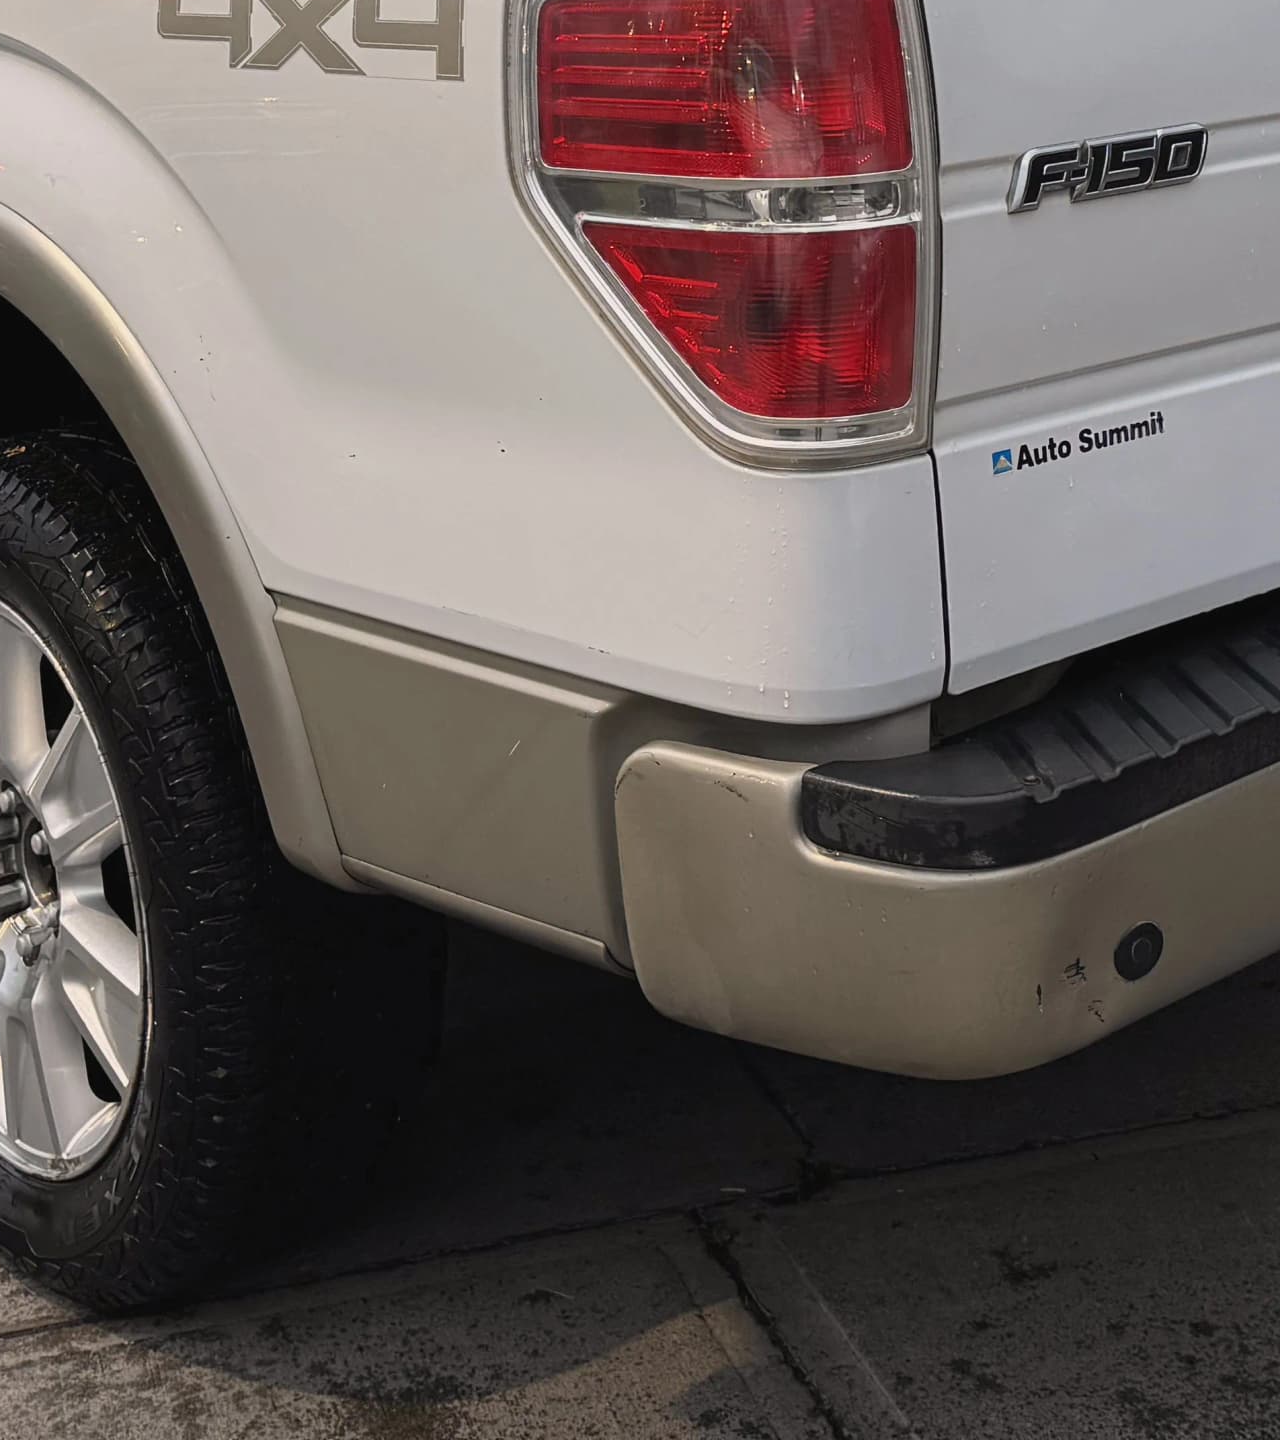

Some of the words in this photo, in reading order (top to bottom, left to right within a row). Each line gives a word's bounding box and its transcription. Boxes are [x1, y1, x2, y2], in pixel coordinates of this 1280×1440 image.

[1007, 122, 1208, 214] F-150
[1017, 432, 1071, 470] Auto
[1078, 411, 1164, 453] Summit
